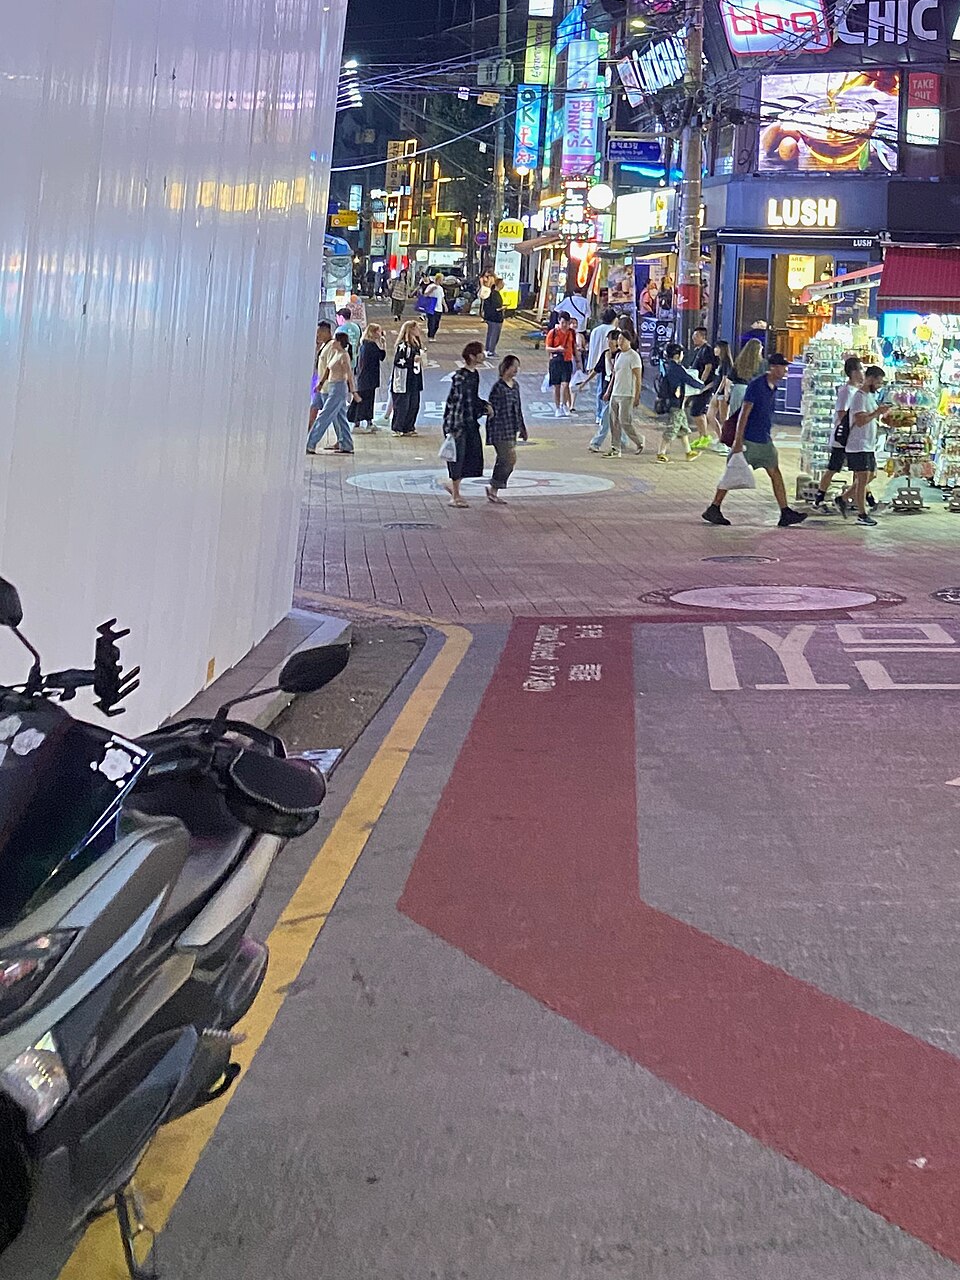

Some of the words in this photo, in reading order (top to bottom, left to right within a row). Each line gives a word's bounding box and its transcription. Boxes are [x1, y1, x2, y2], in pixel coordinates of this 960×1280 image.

[912, 79, 935, 90] TAKE
[914, 91, 931, 100] OUT
[567, 100, 580, 148] PINK'S
[767, 198, 838, 227] LUSH
[853, 239, 872, 247] LUSH
